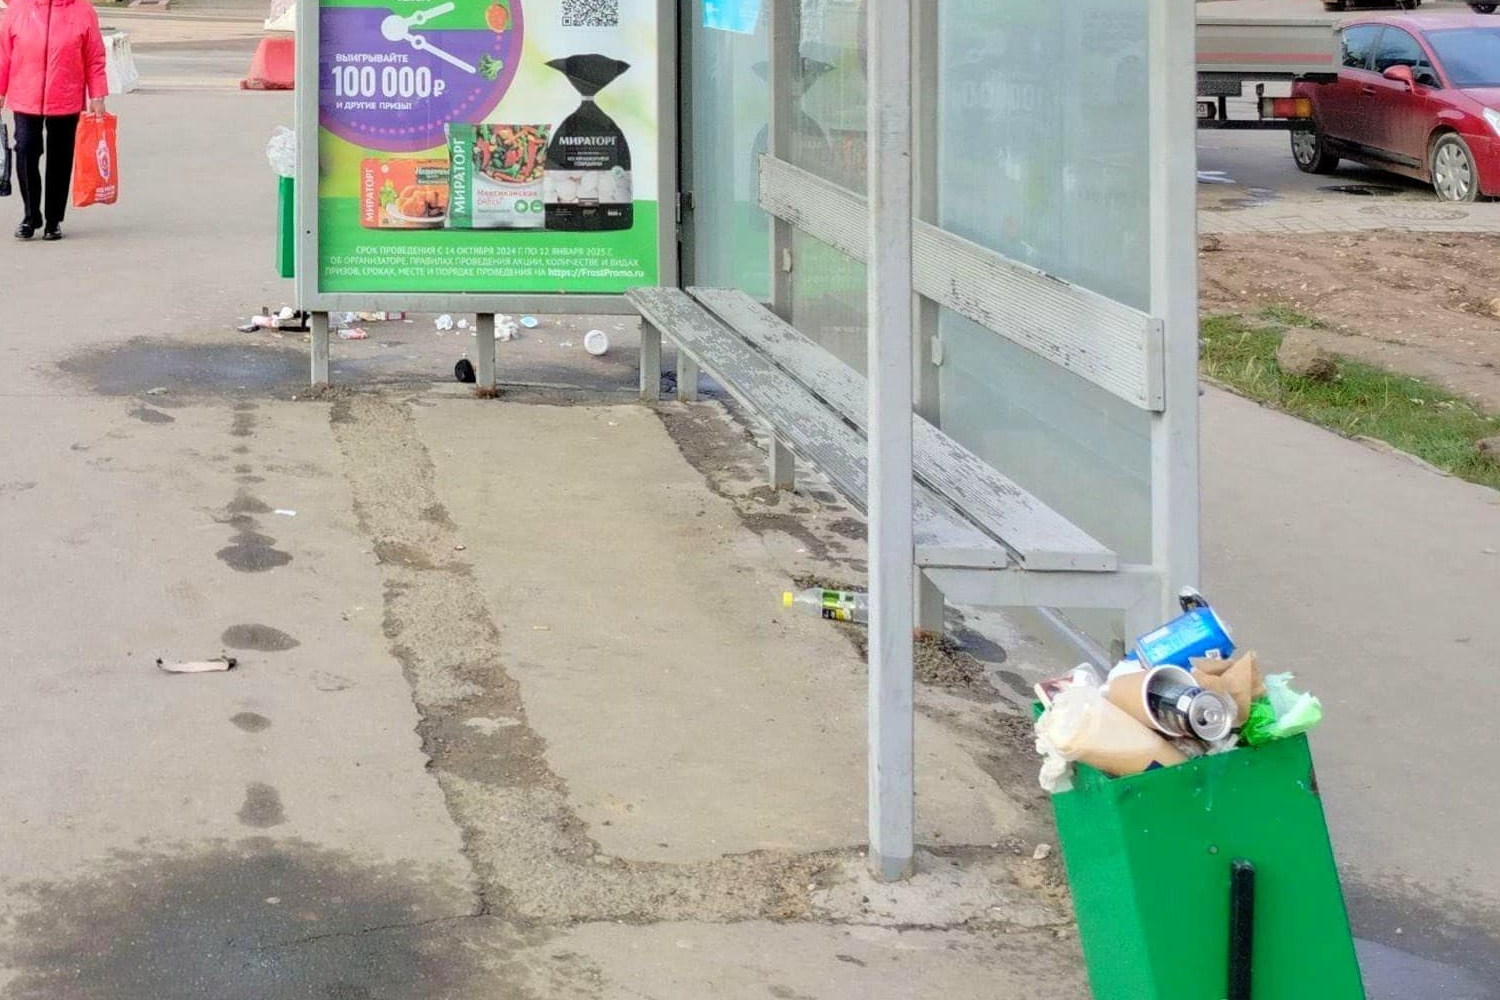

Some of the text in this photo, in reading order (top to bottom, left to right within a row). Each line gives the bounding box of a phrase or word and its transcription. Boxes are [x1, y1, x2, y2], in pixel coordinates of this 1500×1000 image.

[335, 53, 409, 63] ВЫИГРЫВАЙТЕ
[331, 66, 376, 97] 100
[344, 101, 377, 111] ДРУГИЕ
[559, 135, 618, 146] МИРАТОРГ
[453, 137, 466, 214] МИРАТОРГ
[364, 168, 374, 222] МИРАТОРГ
[356, 246, 378, 254] СРОК
[380, 246, 436, 254] ПРОВЕДЕНИЯ
